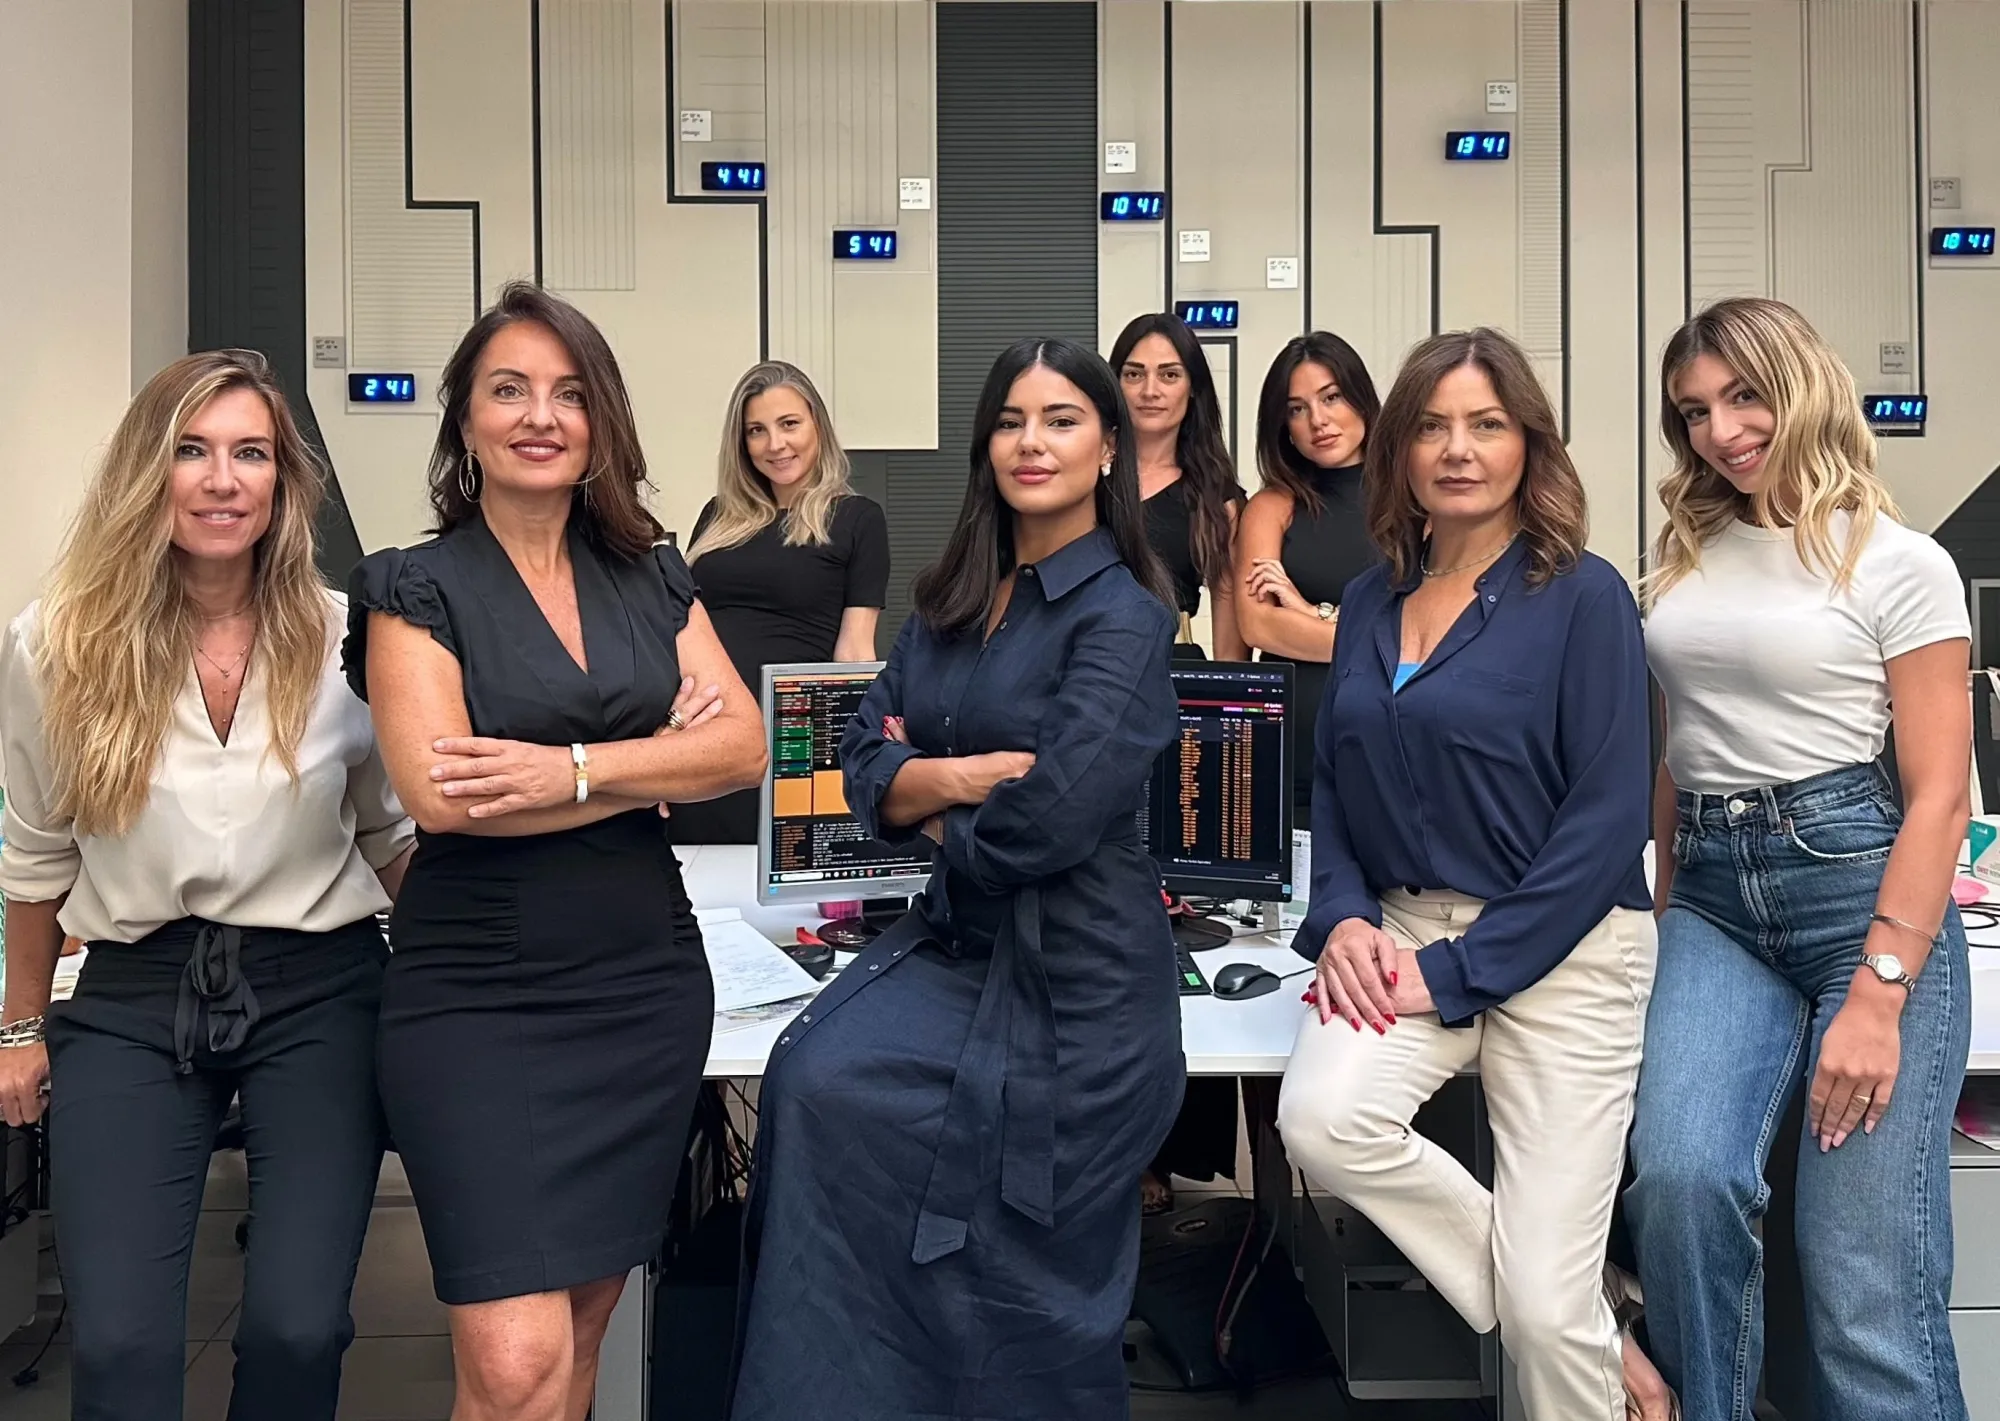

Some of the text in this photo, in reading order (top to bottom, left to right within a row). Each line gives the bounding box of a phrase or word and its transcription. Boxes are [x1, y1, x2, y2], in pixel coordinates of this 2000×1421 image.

[1457, 136, 1505, 154] 13 41
[718, 168, 760, 184] 4 41
[1112, 196, 1159, 214] 10 41
[849, 235, 891, 253] 5 41
[1968, 234, 1990, 249] 41
[1186, 307, 1234, 322] 11 41
[364, 378, 409, 396] 2 41
[1874, 400, 1923, 416] 17 41
